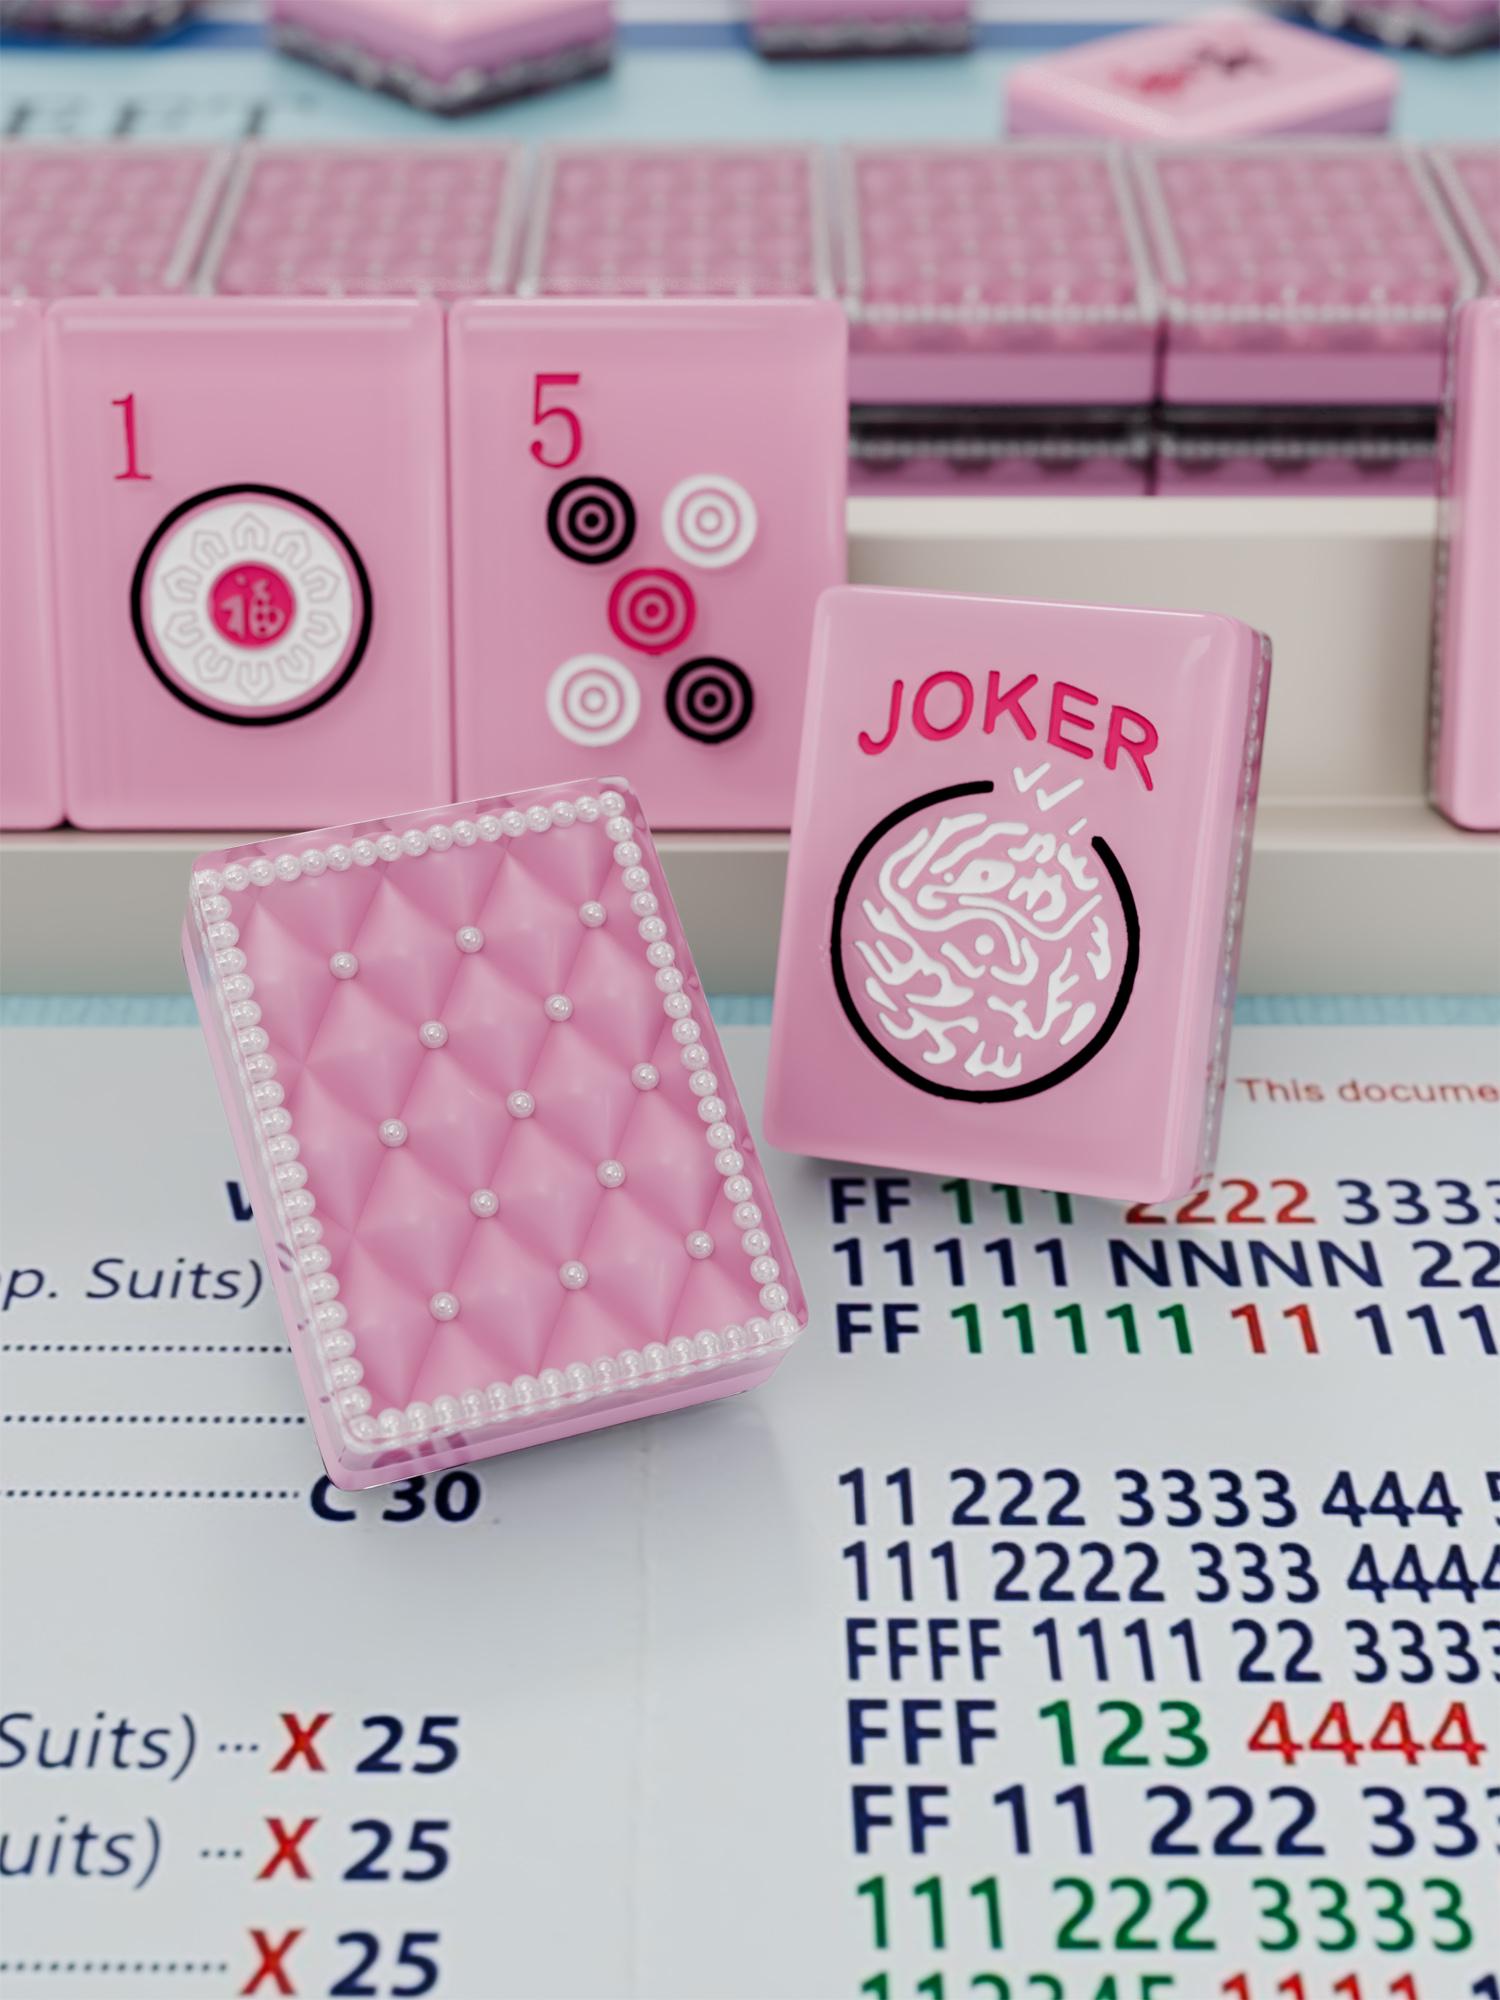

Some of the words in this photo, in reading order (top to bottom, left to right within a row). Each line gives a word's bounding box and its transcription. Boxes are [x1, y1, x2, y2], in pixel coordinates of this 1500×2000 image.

[111, 393, 153, 481] 1
[530, 373, 583, 469] 5
[858, 671, 1159, 791] JOKER
[1236, 1077, 1325, 1102] This
[1337, 1079, 1500, 1102] docume
[830, 1177, 910, 1224] FF
[941, 1178, 1073, 1224] 111
[86, 1257, 263, 1308] Suits)
[833, 1238, 1068, 1287] 11111
[1108, 1239, 1384, 1288] NNNN
[1412, 1240, 1500, 1288] 22
[836, 1302, 919, 1354] FF
[951, 1303, 1194, 1355] 11111
[1231, 1304, 1319, 1355] 11
[1355, 1303, 1499, 1355] 111
[310, 1475, 357, 1521] C
[382, 1471, 481, 1522] 30
[838, 1467, 914, 1526] 11
[950, 1468, 1086, 1527] 222
[1114, 1468, 1298, 1527] 3333
[1322, 1471, 1463, 1528] 444
[842, 1541, 959, 1601] 111
[991, 1541, 1166, 1602] 2222
[1191, 1542, 1320, 1603] 333
[846, 1618, 1001, 1681] FFFF
[1033, 1618, 1202, 1682] 1111
[1231, 1619, 1322, 1682] 22
[0, 1711, 196, 1781] Suits)
[270, 1712, 334, 1772] X
[355, 1715, 459, 1774] 25
[848, 1699, 997, 1766] FFF
[1039, 1699, 1209, 1767] 123
[1247, 1701, 1487, 1767] 4444
[255, 1818, 319, 1880] X
[343, 1819, 450, 1882] 25
[851, 1785, 949, 1855] FF
[993, 1784, 1093, 1855] 11
[1145, 1785, 1326, 1857] 222
[1362, 1787, 1500, 1858] 33
[857, 1876, 1003, 1950] 111
[1052, 1877, 1217, 1951] 222
[1252, 1878, 1473, 1953] 3333
[239, 1929, 304, 1996] X
[329, 1932, 439, 1998] 25
